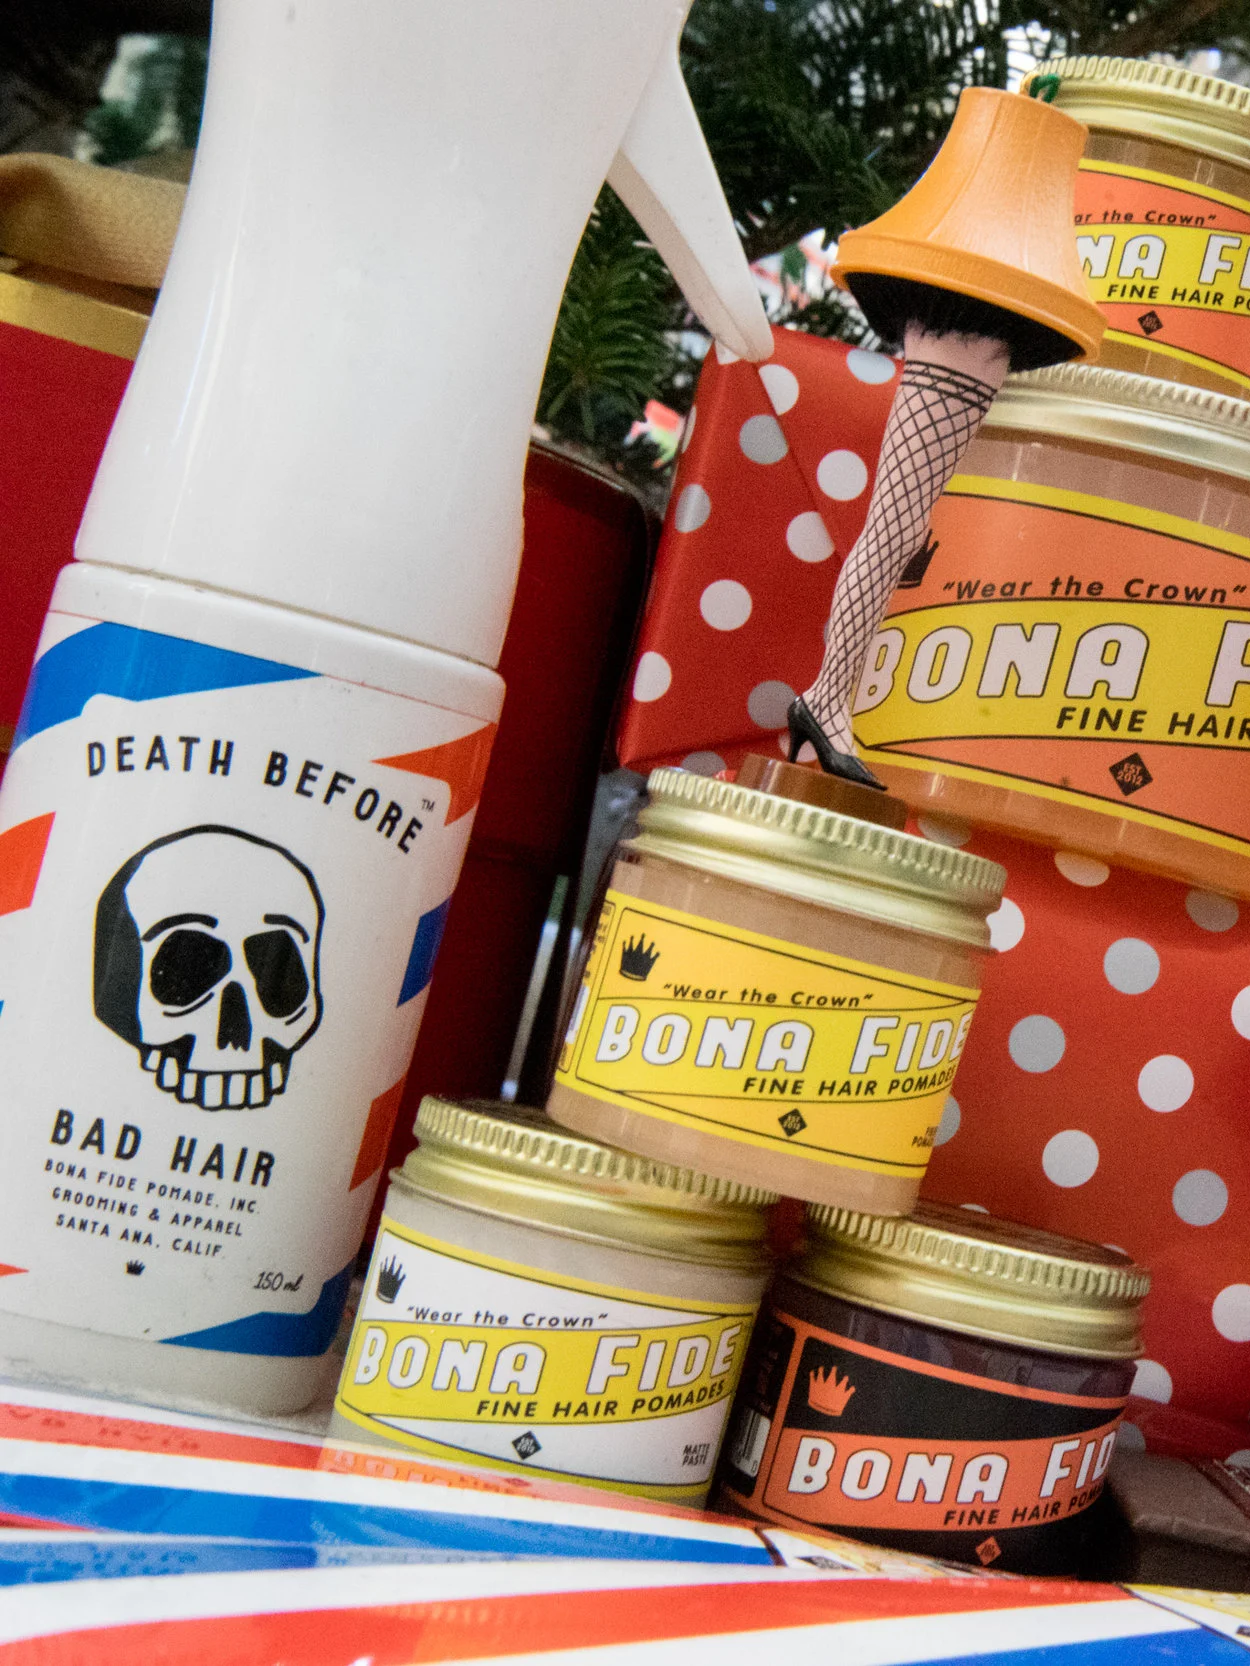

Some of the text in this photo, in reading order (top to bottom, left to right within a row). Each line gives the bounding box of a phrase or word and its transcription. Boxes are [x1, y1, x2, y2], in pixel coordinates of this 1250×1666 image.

[1074, 213, 1092, 225] ar
[1103, 210, 1134, 224] the
[1076, 234, 1167, 280] NA
[1107, 284, 1159, 299] FINE
[1171, 288, 1224, 306] HAIR
[1049, 576, 1103, 597] the
[853, 622, 1150, 715] BONA
[1056, 706, 1148, 732] FINE
[87, 735, 235, 777] DEATH
[740, 987, 778, 1004] the
[595, 1004, 974, 1074] BONA FIDE
[742, 1068, 956, 1097] FINE HAIR POMADES
[50, 1109, 276, 1188] BAD HAIR
[44, 1158, 87, 1181] BONA
[97, 1170, 138, 1192] FIDE
[51, 1187, 243, 1237] GROOMING & APPAREL
[55, 1213, 110, 1238] SANTA
[474, 1309, 509, 1325] the
[353, 1326, 547, 1396] BONA
[585, 1323, 742, 1396] FIDE
[476, 1380, 725, 1418] FINE HAIR POMADES
[787, 1430, 1117, 1504] BONA FID
[943, 1509, 1000, 1527] FINE
[1011, 1501, 1061, 1522] HAIR
